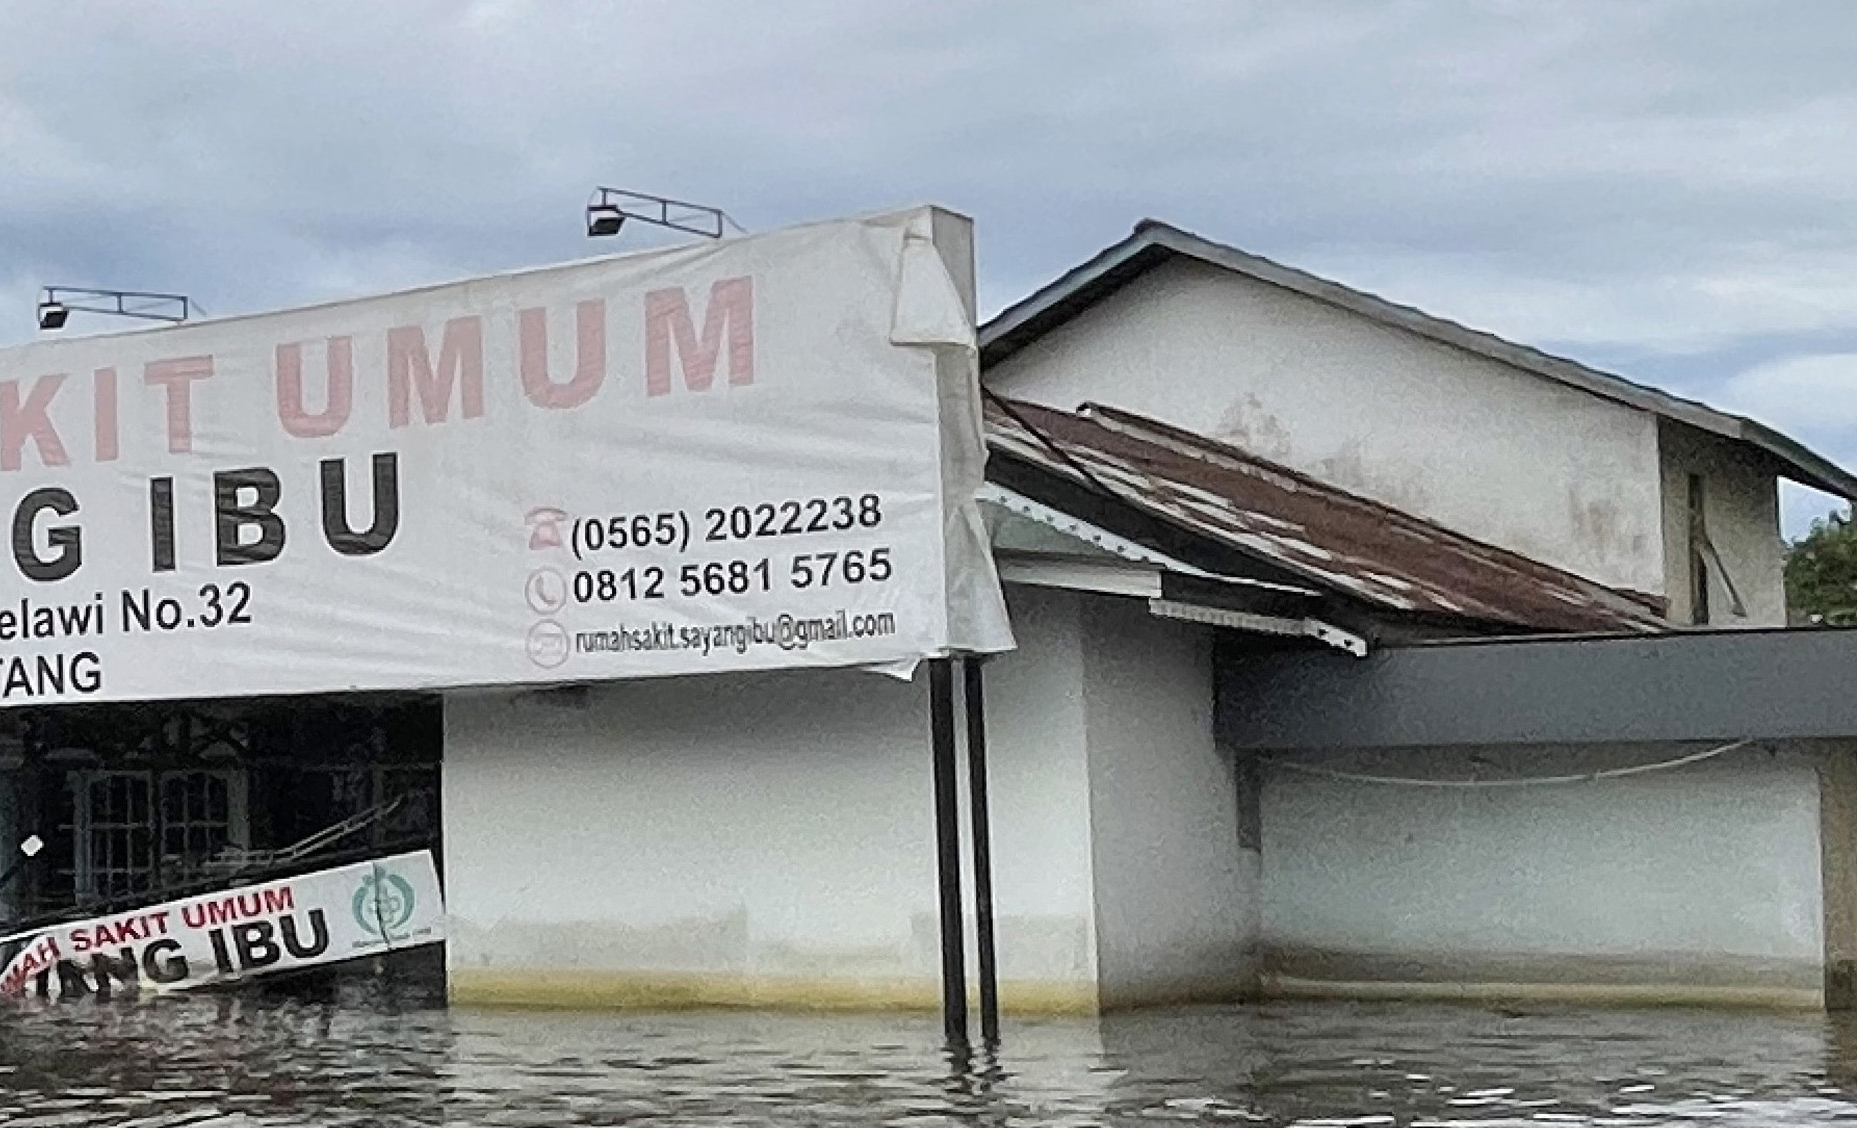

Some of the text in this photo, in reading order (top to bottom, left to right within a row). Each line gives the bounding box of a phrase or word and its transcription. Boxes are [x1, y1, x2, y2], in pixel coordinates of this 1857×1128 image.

[275, 275, 755, 439] UMUM
[149, 453, 399, 572] IBU
[572, 493, 882, 561] (0565) 2022238
[122, 581, 252, 632] No.32
[572, 547, 893, 603] 0812 5681 5765
[574, 609, 896, 656] rumahsakit.sayangibu@gmail.com
[69, 911, 170, 952] SAKIT
[181, 886, 295, 929] UMUM
[208, 908, 330, 974] IBU
